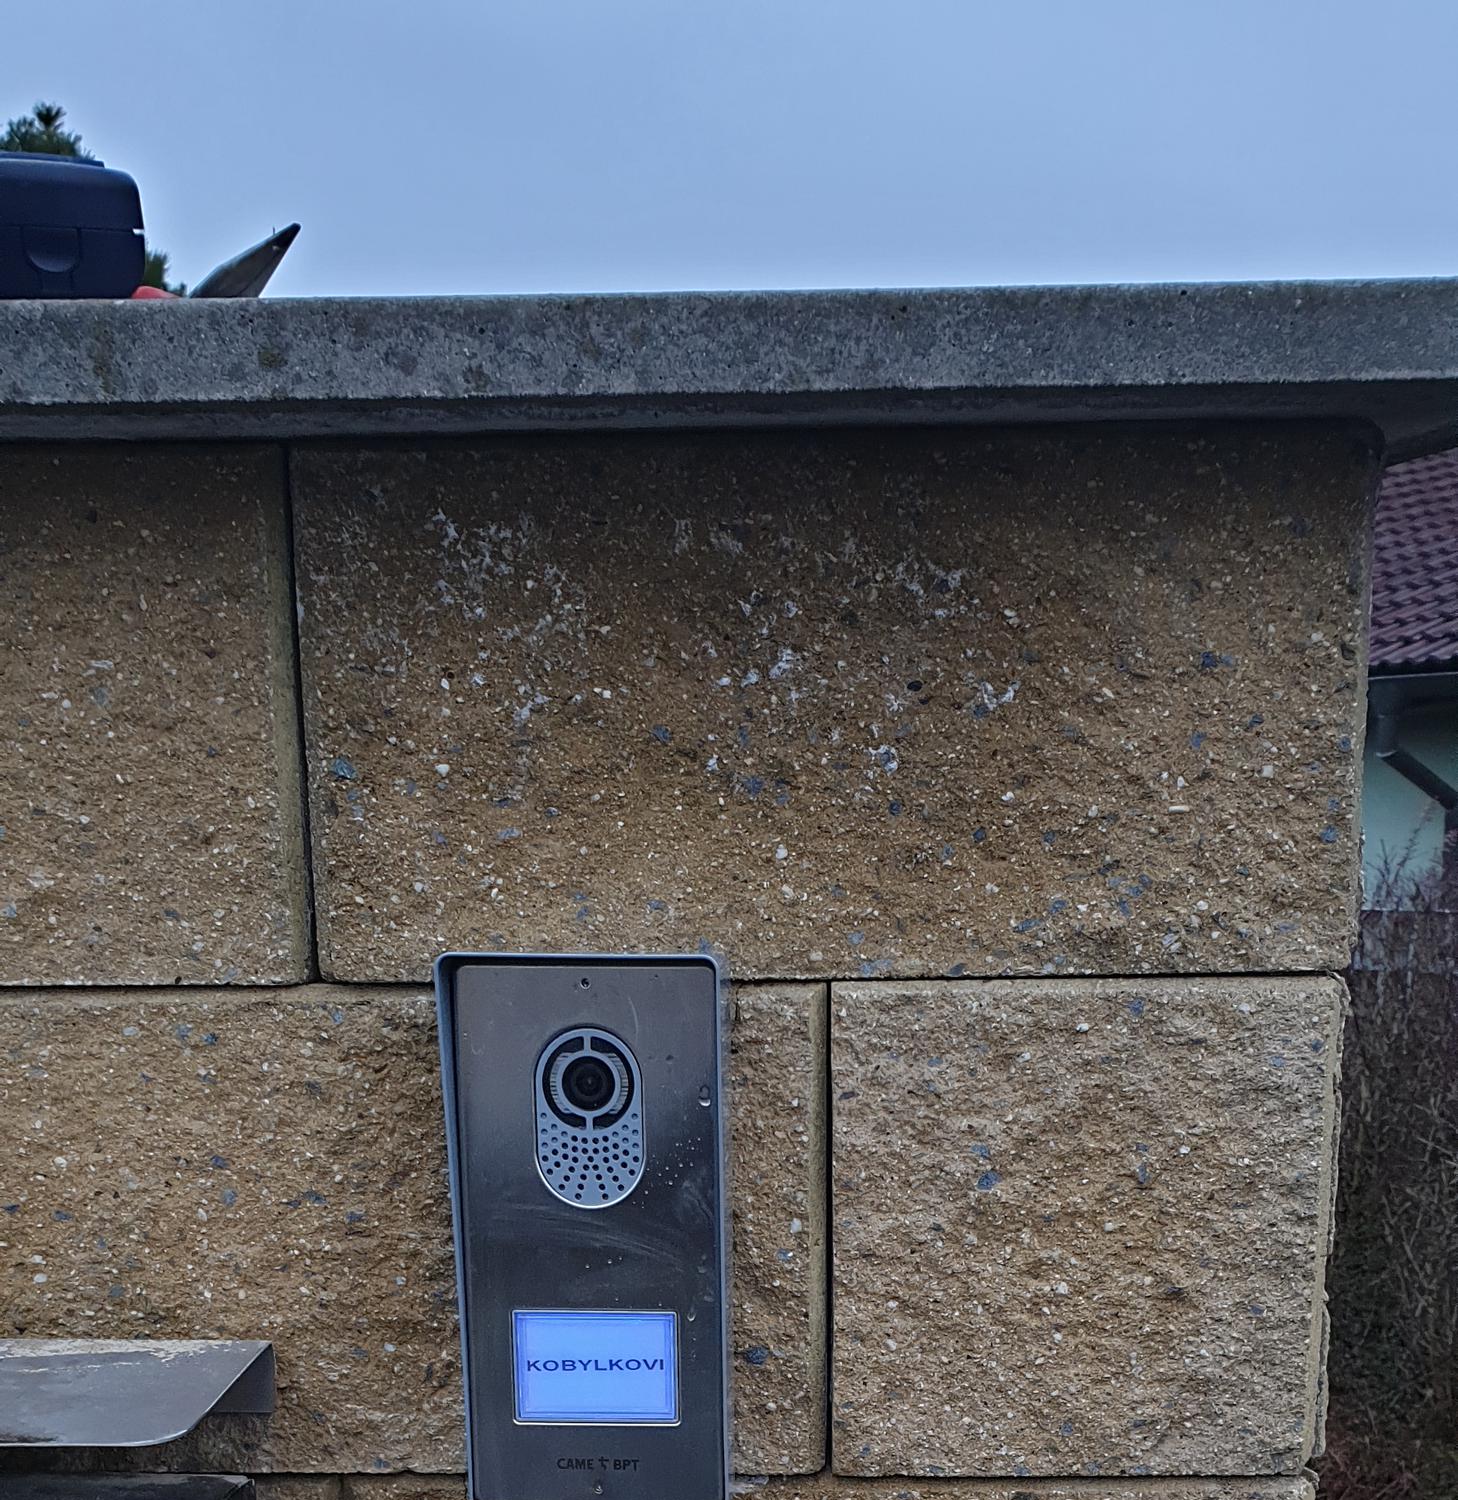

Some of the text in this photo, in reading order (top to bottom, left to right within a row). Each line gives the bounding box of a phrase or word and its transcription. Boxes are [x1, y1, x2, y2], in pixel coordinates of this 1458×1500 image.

[527, 1358, 664, 1372] KOBYLKOVI
[556, 1457, 640, 1471] CAME BPT
